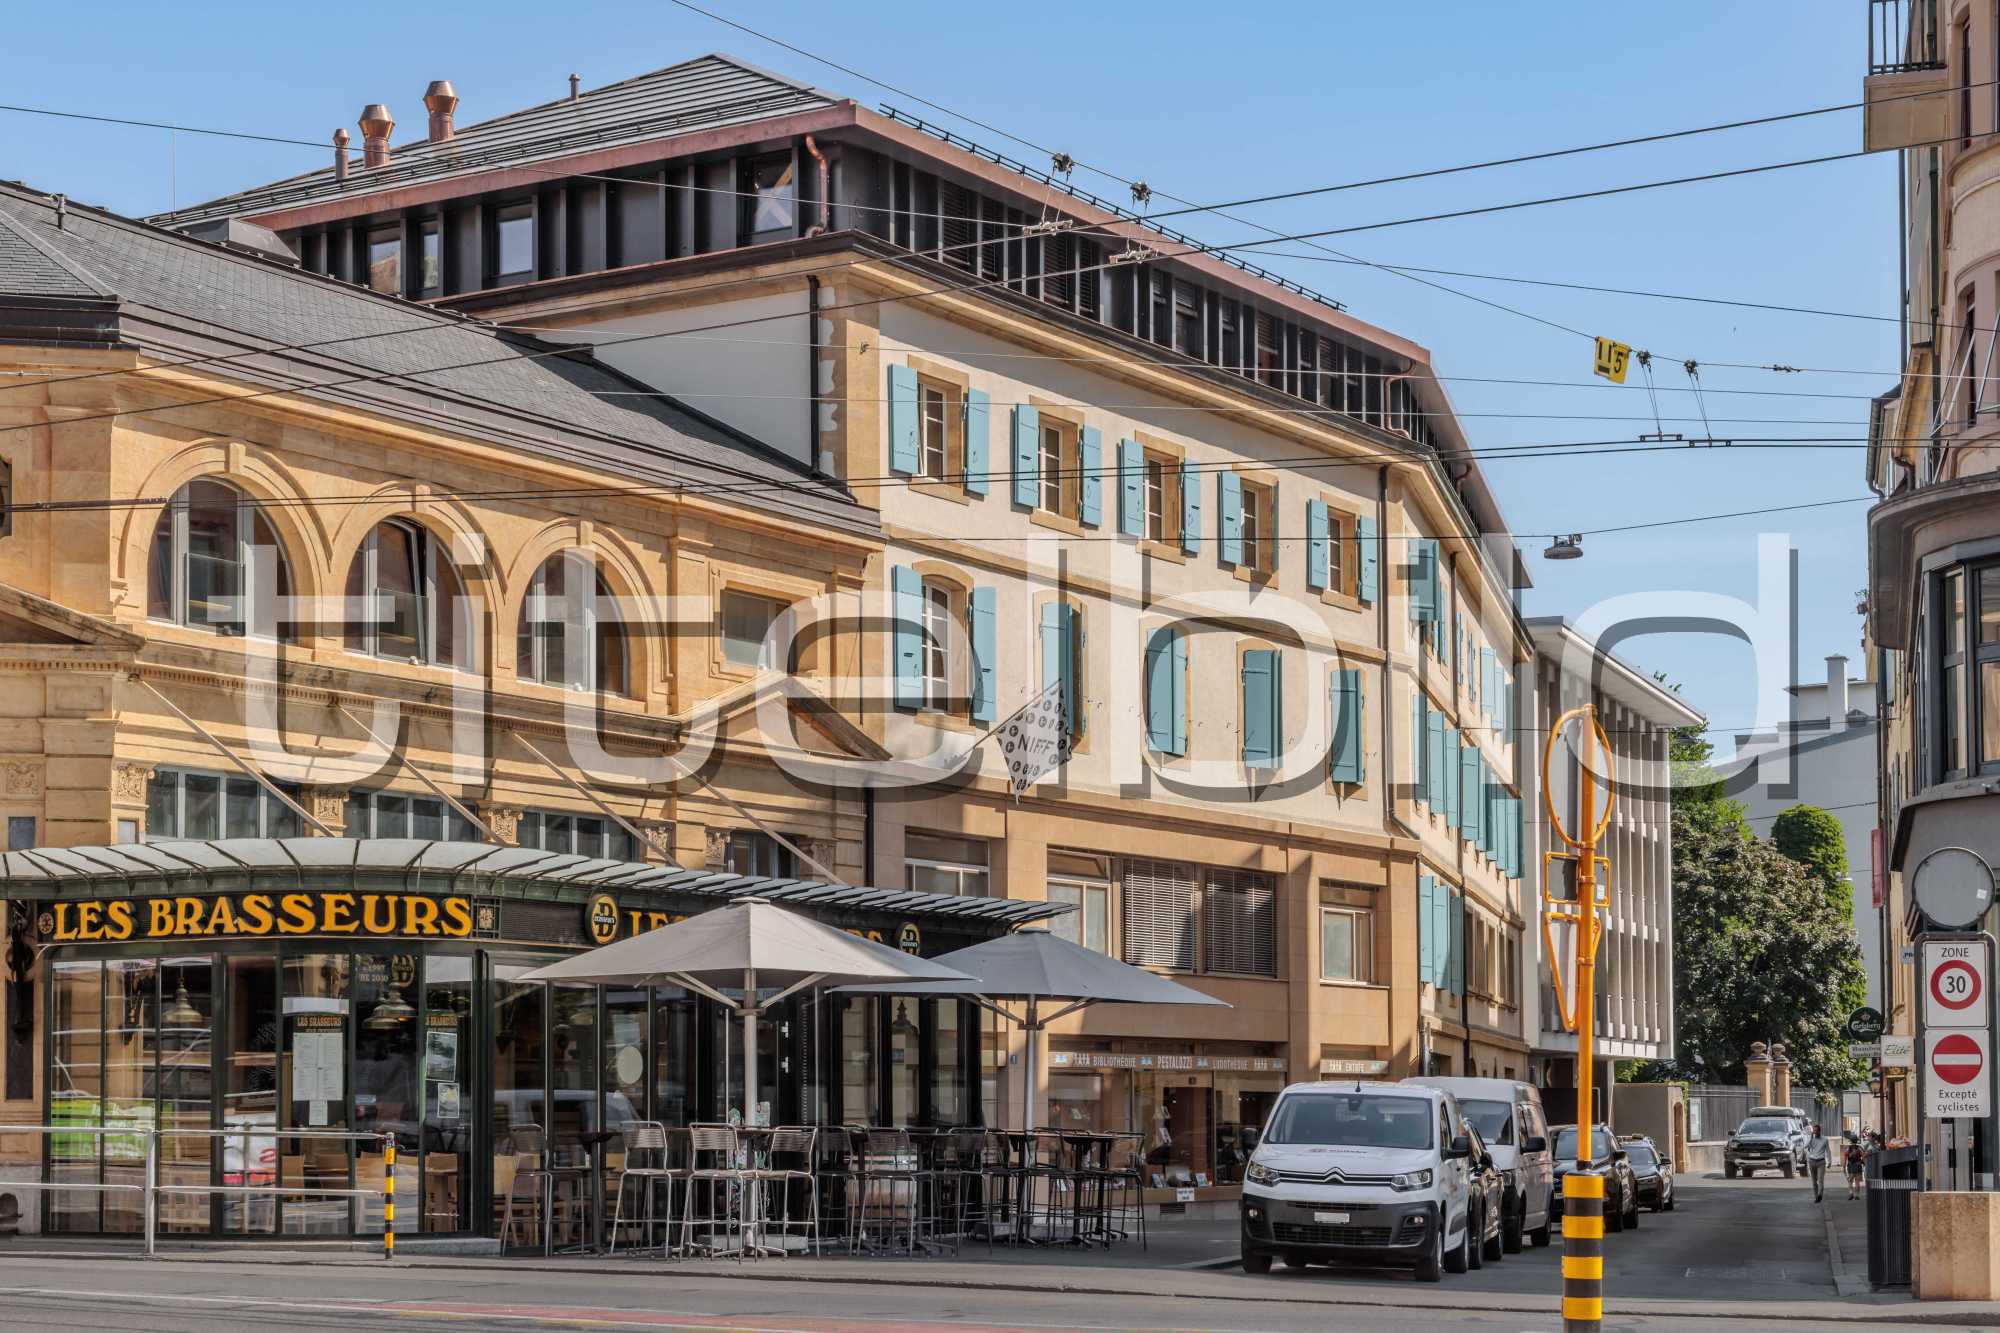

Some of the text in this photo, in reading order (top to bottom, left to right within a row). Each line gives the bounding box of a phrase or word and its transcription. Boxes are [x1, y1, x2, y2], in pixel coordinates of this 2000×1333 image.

[53, 893, 473, 940] LES BRASSEURS
[1941, 947, 1969, 958] ZONE
[1946, 975, 1966, 994] 30
[1938, 1088, 1978, 1100] Excepté
[1937, 1101, 1981, 1114] cyclistes
